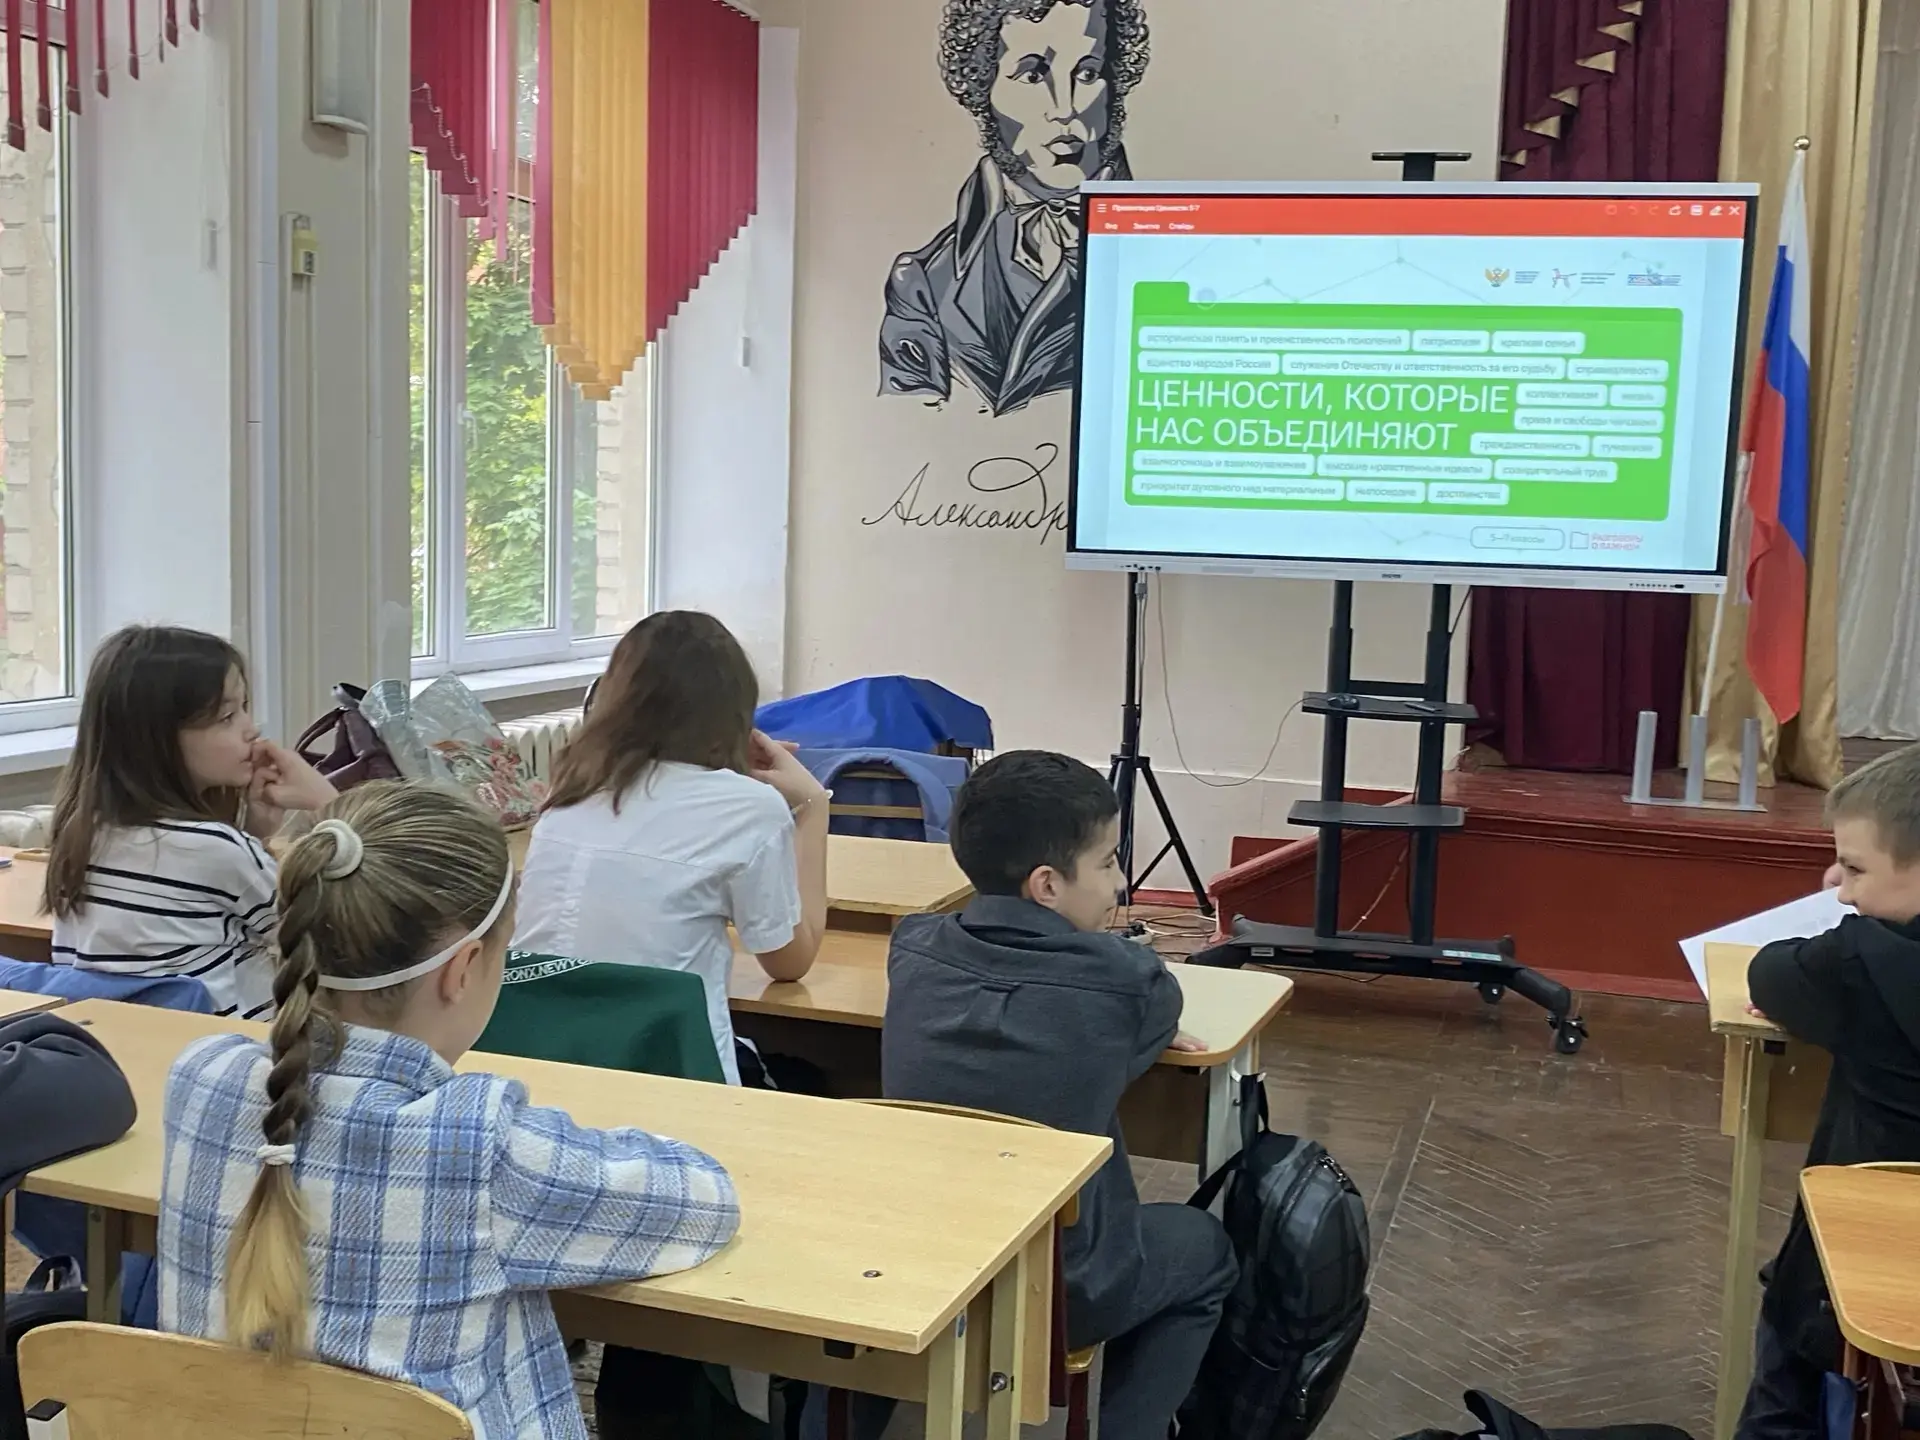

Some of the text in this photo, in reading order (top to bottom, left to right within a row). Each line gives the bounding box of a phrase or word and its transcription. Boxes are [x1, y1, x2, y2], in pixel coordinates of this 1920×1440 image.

[1138, 379, 1510, 415] ЦЕННОСТИ, КОТОРЫЕ
[1136, 417, 1457, 452] НАС ОБЪЕДИНЯЮТ
